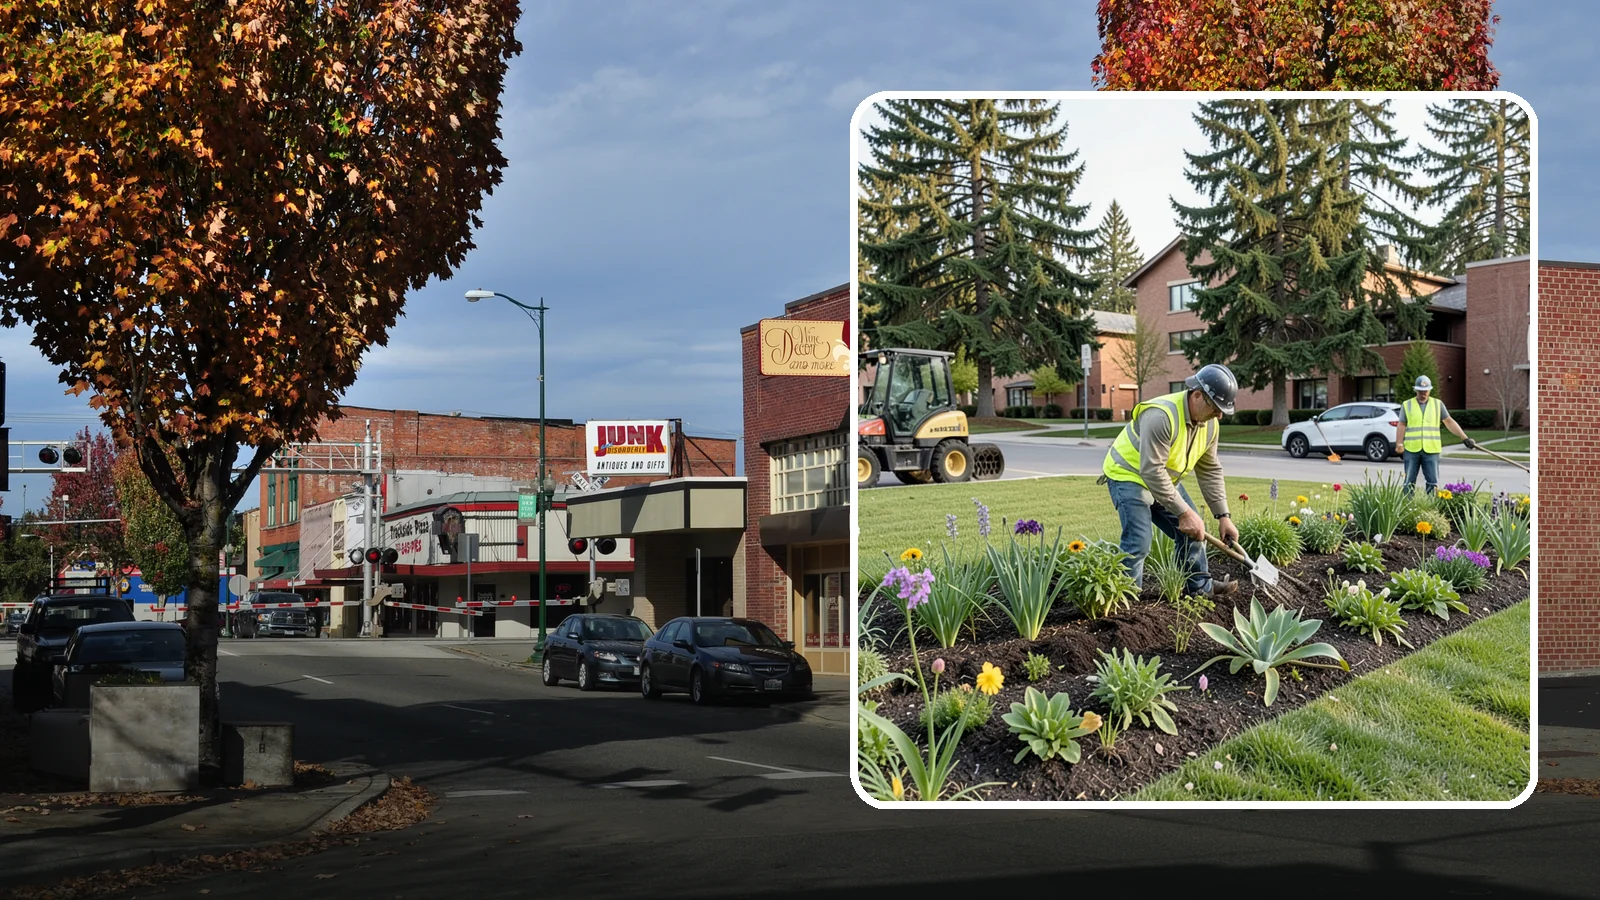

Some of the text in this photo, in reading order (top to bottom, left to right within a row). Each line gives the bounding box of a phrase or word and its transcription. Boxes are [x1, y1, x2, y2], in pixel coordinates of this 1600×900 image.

[765, 328, 830, 365] Decor
[596, 425, 664, 457] JUNK
[607, 446, 646, 454] DISORDERLY
[597, 460, 666, 470] ANTIQUES AND GIFTS
[573, 473, 589, 492] RAIL
[414, 519, 429, 535] Pizza
